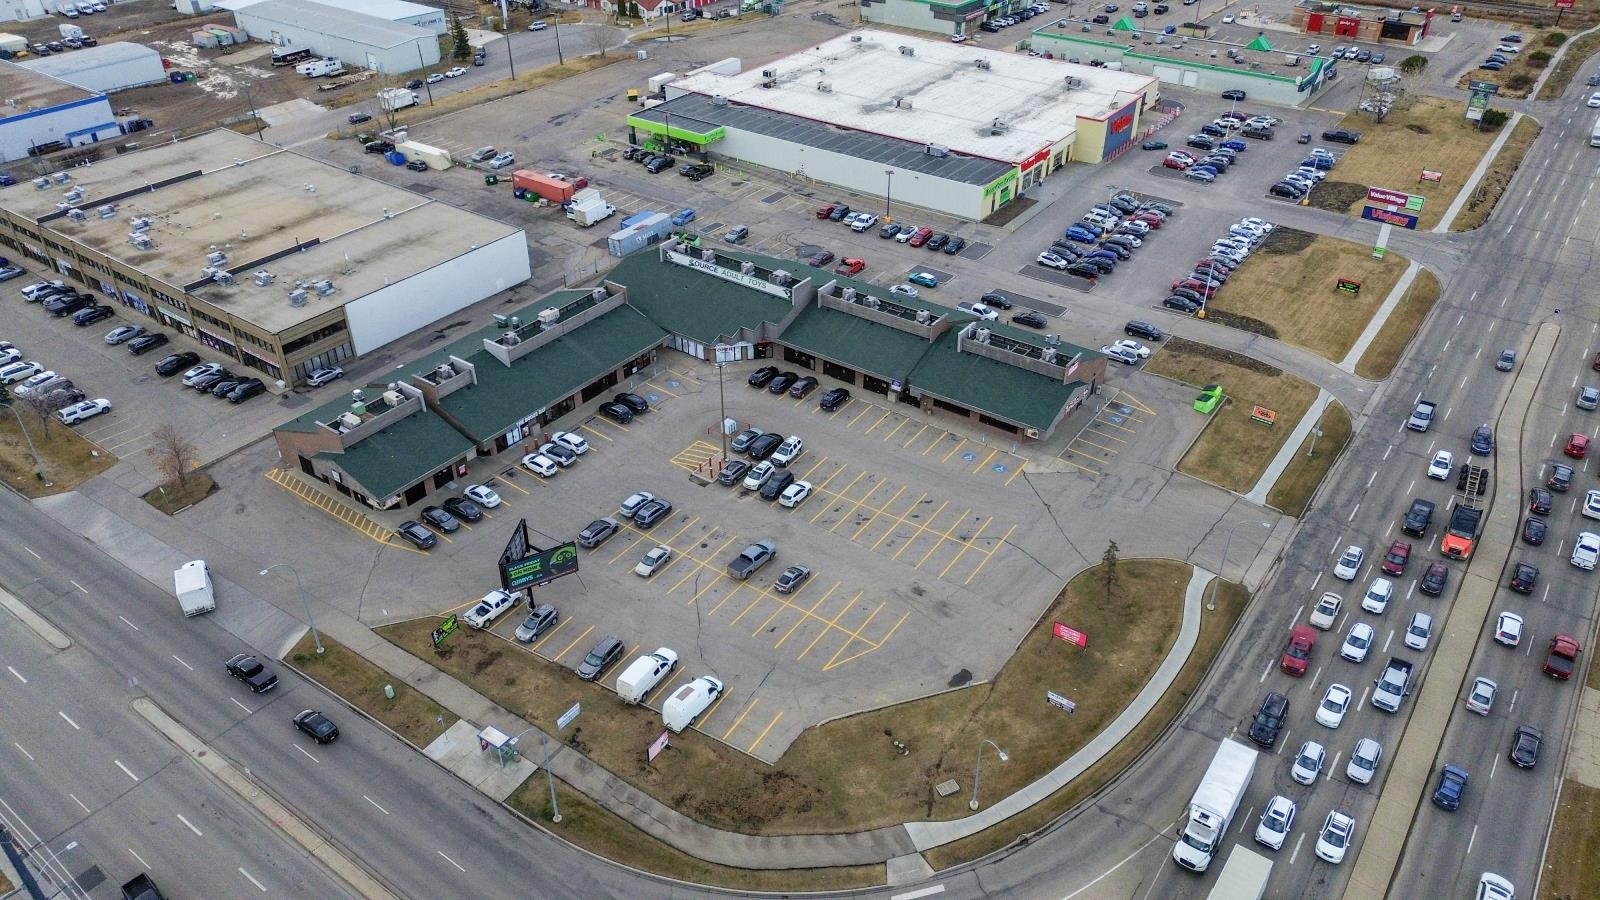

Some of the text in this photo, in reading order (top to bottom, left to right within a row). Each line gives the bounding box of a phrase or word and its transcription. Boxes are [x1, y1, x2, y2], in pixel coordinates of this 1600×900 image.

[689, 259, 767, 289] SOURCE ADULT TOYS
[509, 559, 540, 572] BLACK FRIDAY
